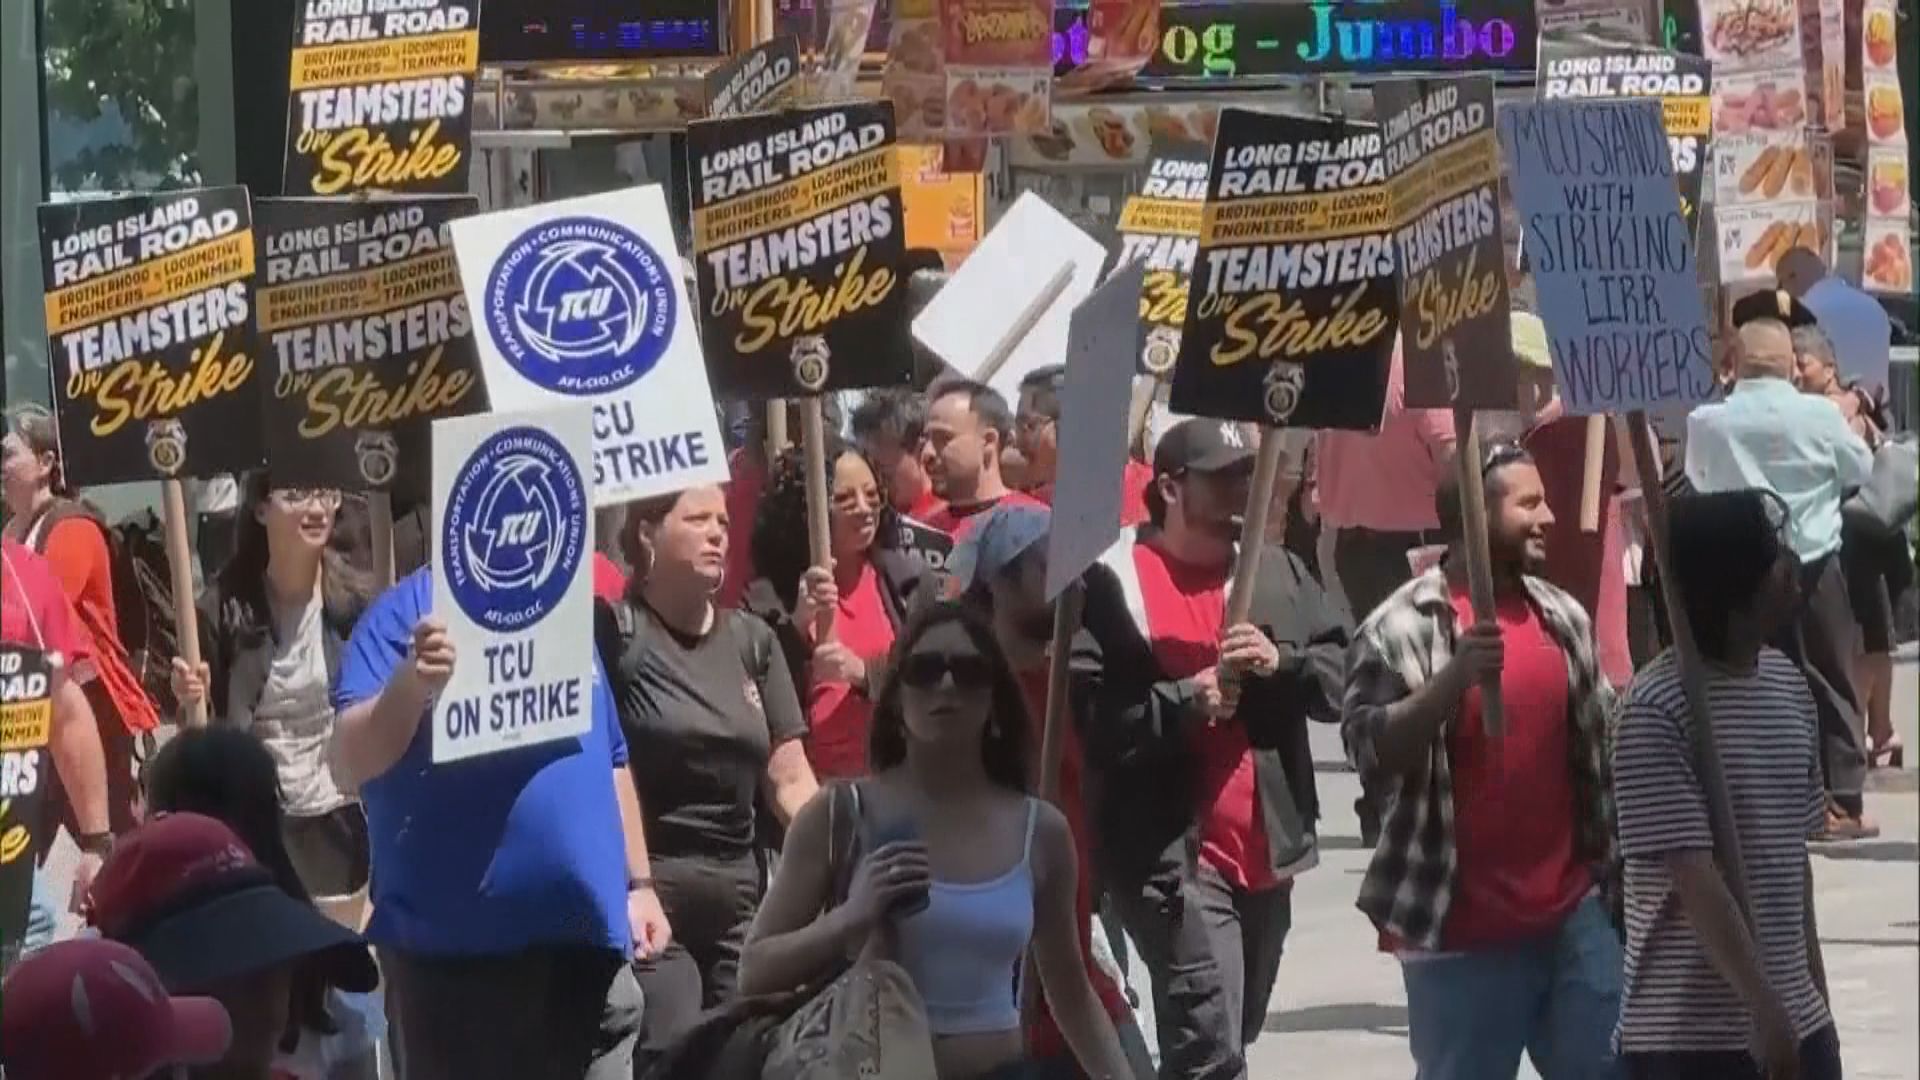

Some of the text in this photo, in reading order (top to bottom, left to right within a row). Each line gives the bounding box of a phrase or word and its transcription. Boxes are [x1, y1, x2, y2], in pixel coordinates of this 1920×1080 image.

[303, 6, 469, 45] RAIL ROAD
[304, 46, 391, 66] BROTHERHOOD
[402, 37, 467, 56] LOCOMOTIVE
[1163, 24, 1236, 78] og
[1297, 0, 1515, 62] Jumbo
[303, 62, 381, 81] ENGINEERS
[402, 52, 466, 71] TRAINMEN
[741, 57, 791, 113] ROAD
[1545, 75, 1616, 98] RAIL
[1621, 73, 1703, 96] ROAD
[1547, 55, 1676, 77] LONG ISLAND
[301, 75, 466, 130] TEAMSTERS
[311, 119, 461, 194] Strike
[701, 112, 847, 176] LONG ISLAND
[703, 161, 783, 204] RAIL
[790, 124, 885, 176] ROAD
[1151, 158, 1208, 179] LONG
[1225, 133, 1381, 169] LONG ISLAND
[1386, 138, 1421, 176] RAIL
[1420, 102, 1485, 155] ROAD
[706, 185, 799, 223] BROTHERHOOD
[812, 153, 885, 189] LOCOMOTIVE
[707, 171, 888, 241] ENGINEERS TRAINMEN
[1215, 201, 1318, 222] BROTHERHOOD
[1332, 191, 1390, 211] LOCOMO
[1218, 158, 1385, 198] RAIL ROA
[1563, 184, 1634, 213] WITH
[53, 198, 198, 260] LONG ISLAND
[55, 209, 238, 286] RAIL ROAD
[266, 206, 424, 257] LONG ISLAND
[708, 195, 892, 292] TEAMSTERS
[1212, 217, 1305, 241] ENGINEERS
[1329, 208, 1389, 230] TRAINM
[1397, 186, 1494, 280] TEAMSTERS
[1531, 211, 1687, 274] STRIKING
[59, 240, 240, 309] BROTHERHOOD LOCOMOTIVE
[60, 257, 242, 325] ENGINEERS TRAINMEN
[267, 247, 349, 283] RAIL
[270, 278, 367, 306] BROTHERHOOD
[538, 225, 663, 284] COMMUNICATIONS
[652, 286, 668, 338] UNION
[1207, 233, 1395, 294] TEAMSTERS
[62, 280, 248, 375] TEAMSTERS
[270, 295, 360, 323] ENGINEERS
[559, 286, 613, 323] TCU
[735, 244, 896, 353] Strike
[1210, 279, 1388, 366] Strike
[1416, 244, 1500, 350] Strike
[1580, 274, 1666, 325] LIRR
[272, 294, 471, 377] TEAMSTERS
[1555, 327, 1717, 404] WORKERS
[90, 330, 253, 436] Strike
[298, 345, 476, 439] Strike
[593, 400, 634, 441] CU
[496, 510, 542, 548] TCU
[563, 513, 582, 572] UNION
[484, 639, 534, 685] TCU
[446, 677, 580, 740] ON STRIKE
